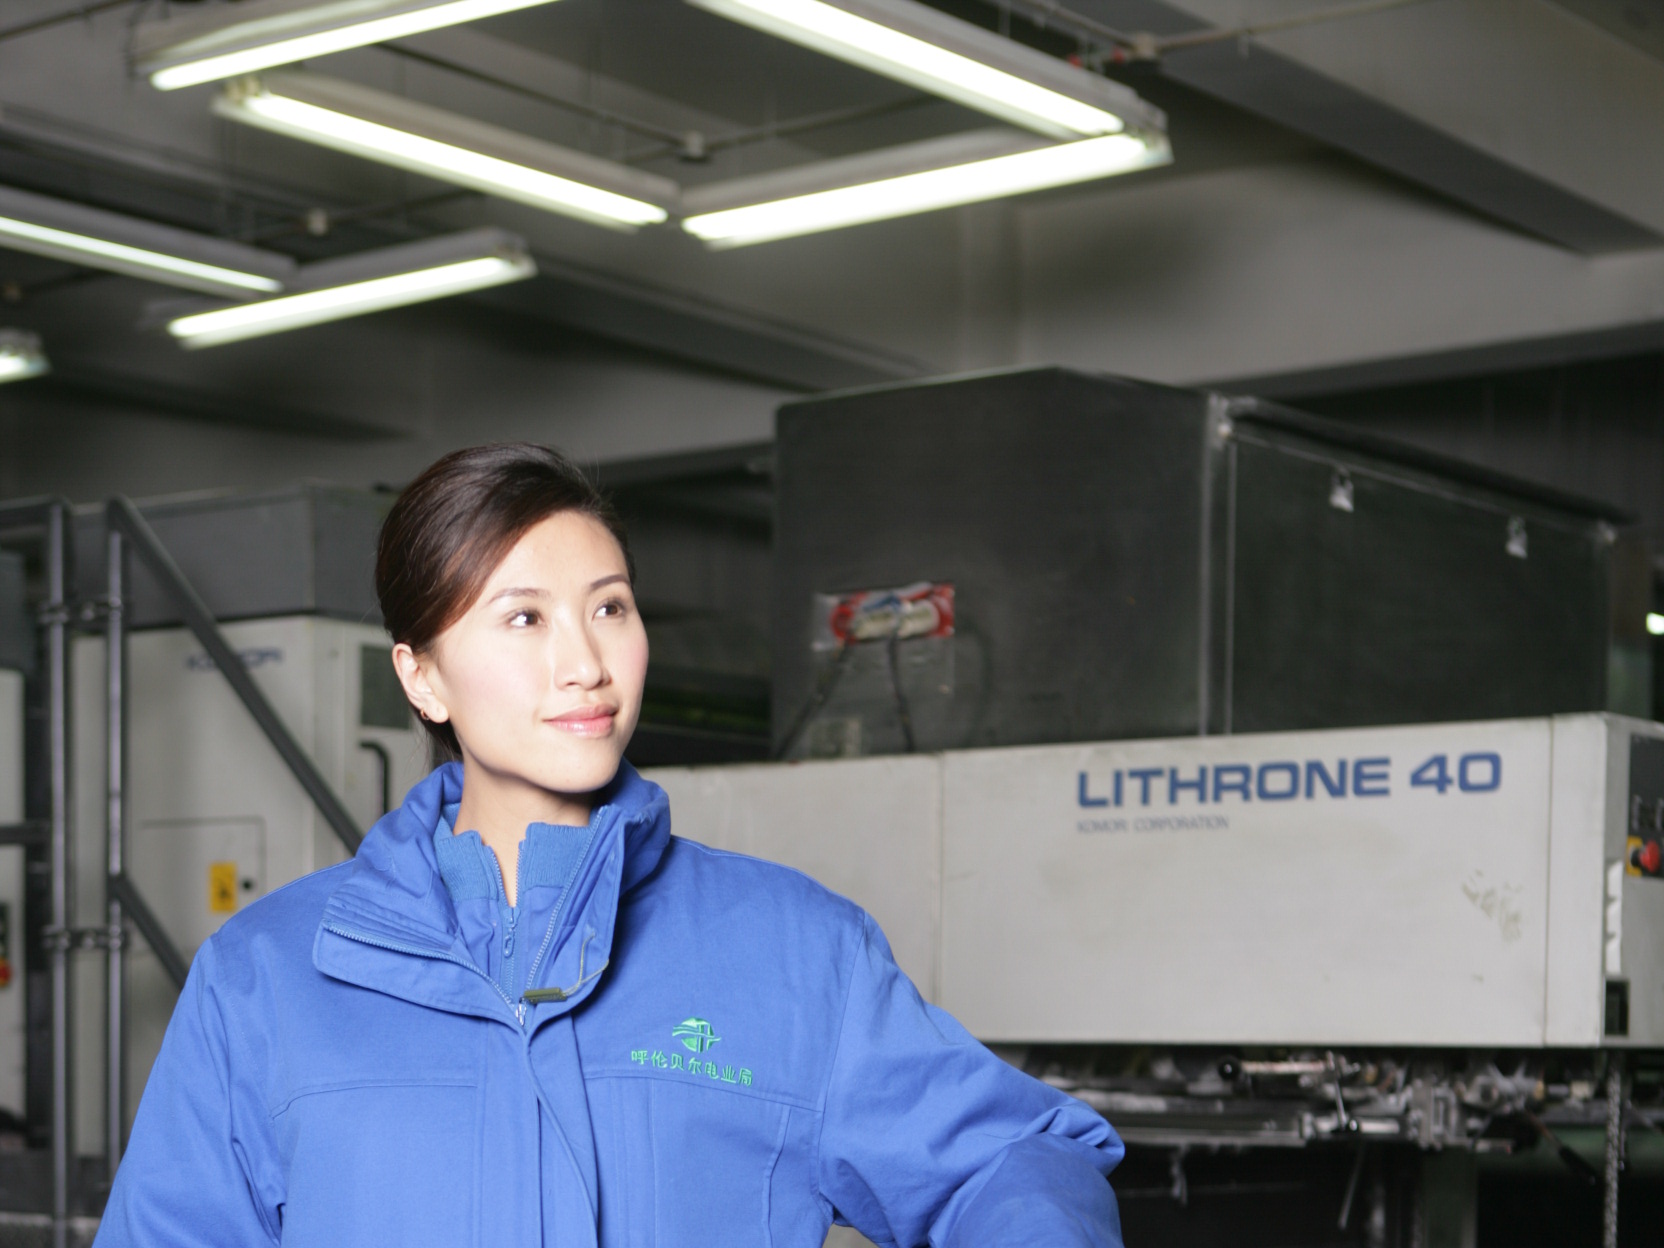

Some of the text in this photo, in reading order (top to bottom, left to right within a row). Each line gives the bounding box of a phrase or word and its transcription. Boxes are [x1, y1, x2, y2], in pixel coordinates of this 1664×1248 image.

[1078, 752, 1503, 809] LITHRONE 40
[1134, 814, 1230, 832] CORPORATION
[630, 1050, 753, 1087] 呼伦贝尔电业局
